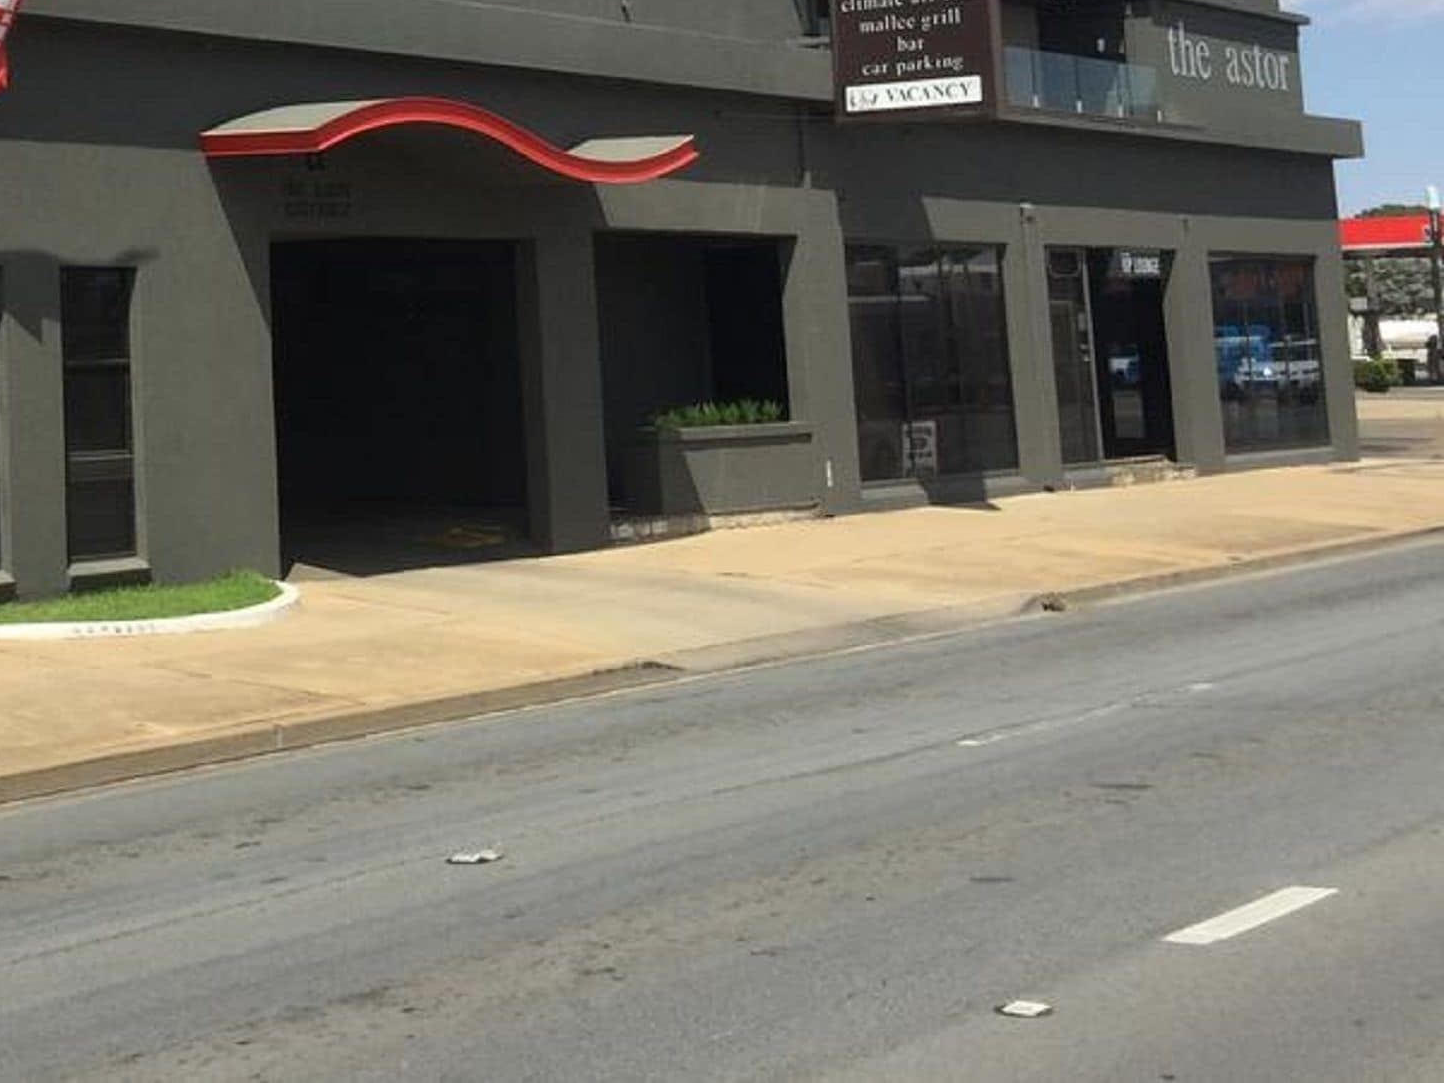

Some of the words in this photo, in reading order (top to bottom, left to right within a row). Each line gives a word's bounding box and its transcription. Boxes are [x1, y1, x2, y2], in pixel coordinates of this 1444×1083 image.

[921, 8, 961, 32] grill
[897, 36, 925, 52] bar
[861, 63, 888, 76] car
[896, 55, 964, 77] parking
[1168, 21, 1212, 78] the
[1225, 44, 1289, 91] astor
[886, 82, 972, 102] VACANCY
